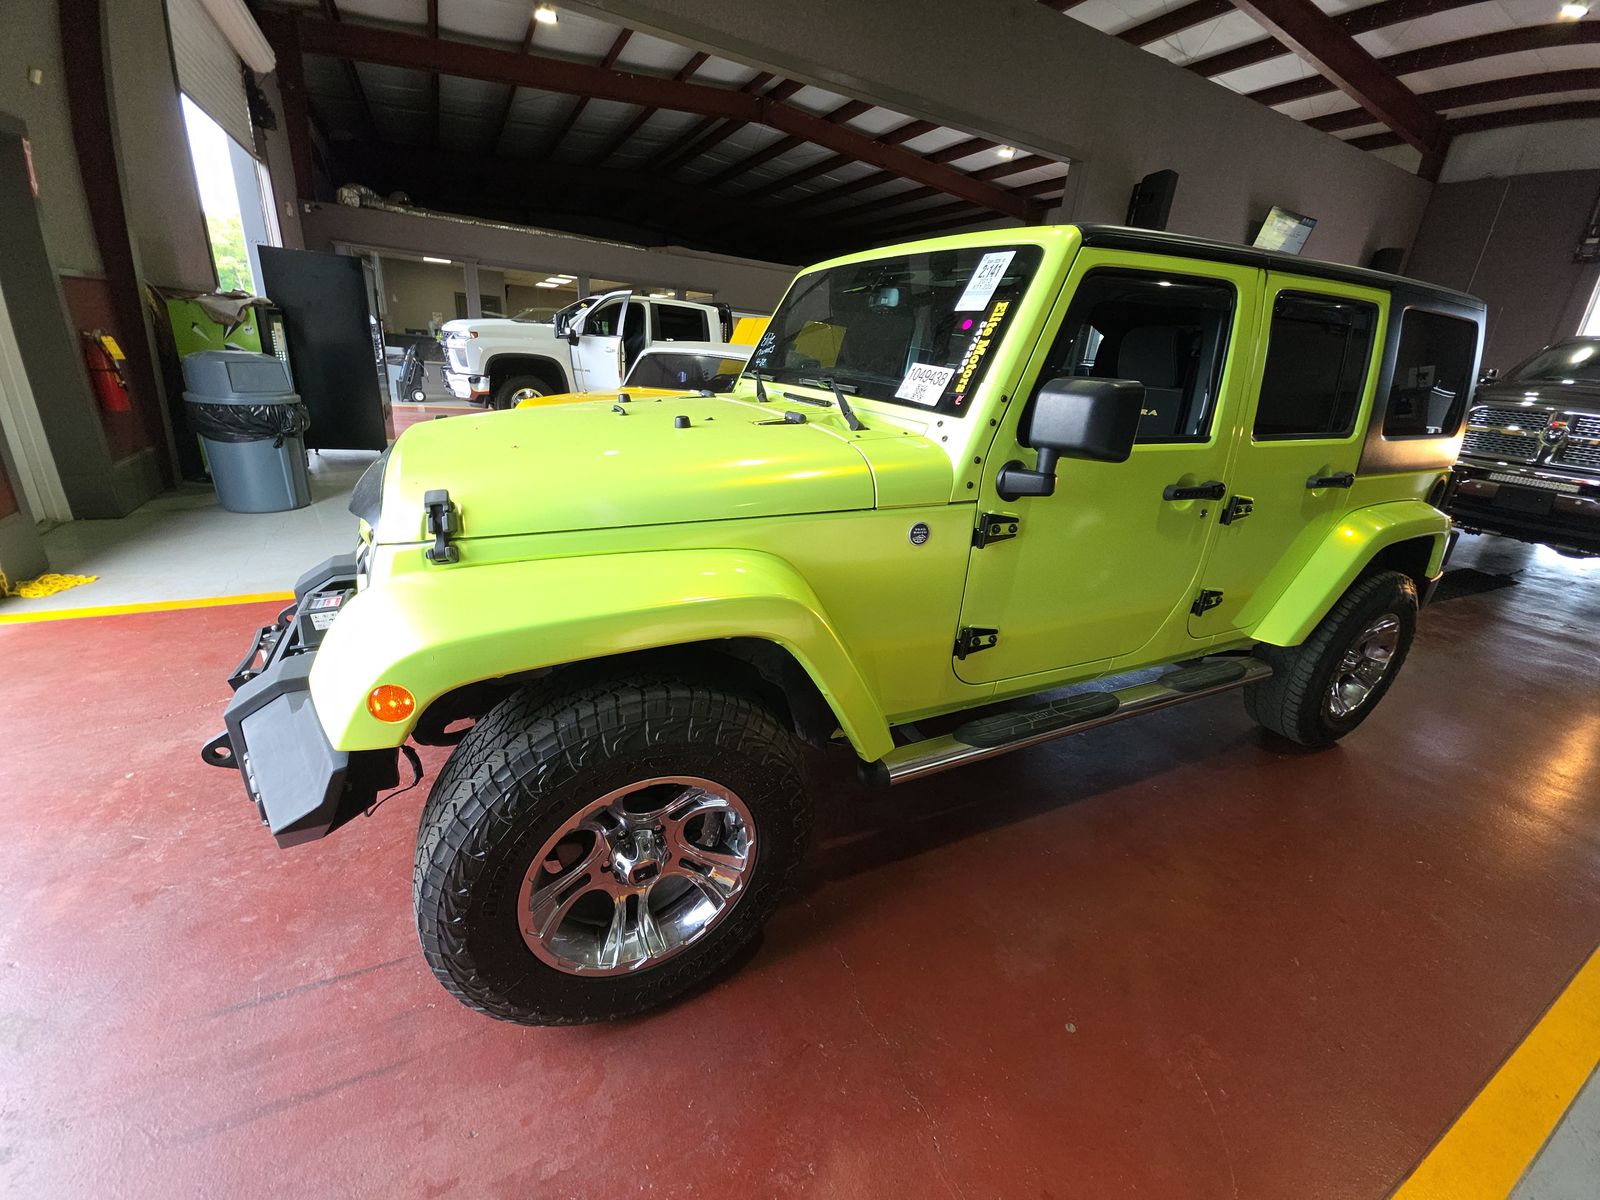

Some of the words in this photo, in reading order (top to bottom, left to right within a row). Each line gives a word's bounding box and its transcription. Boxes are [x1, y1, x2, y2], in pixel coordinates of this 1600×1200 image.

[982, 301, 1010, 337] Elite
[908, 367, 949, 387] 1049438
[955, 339, 991, 393] Motors
